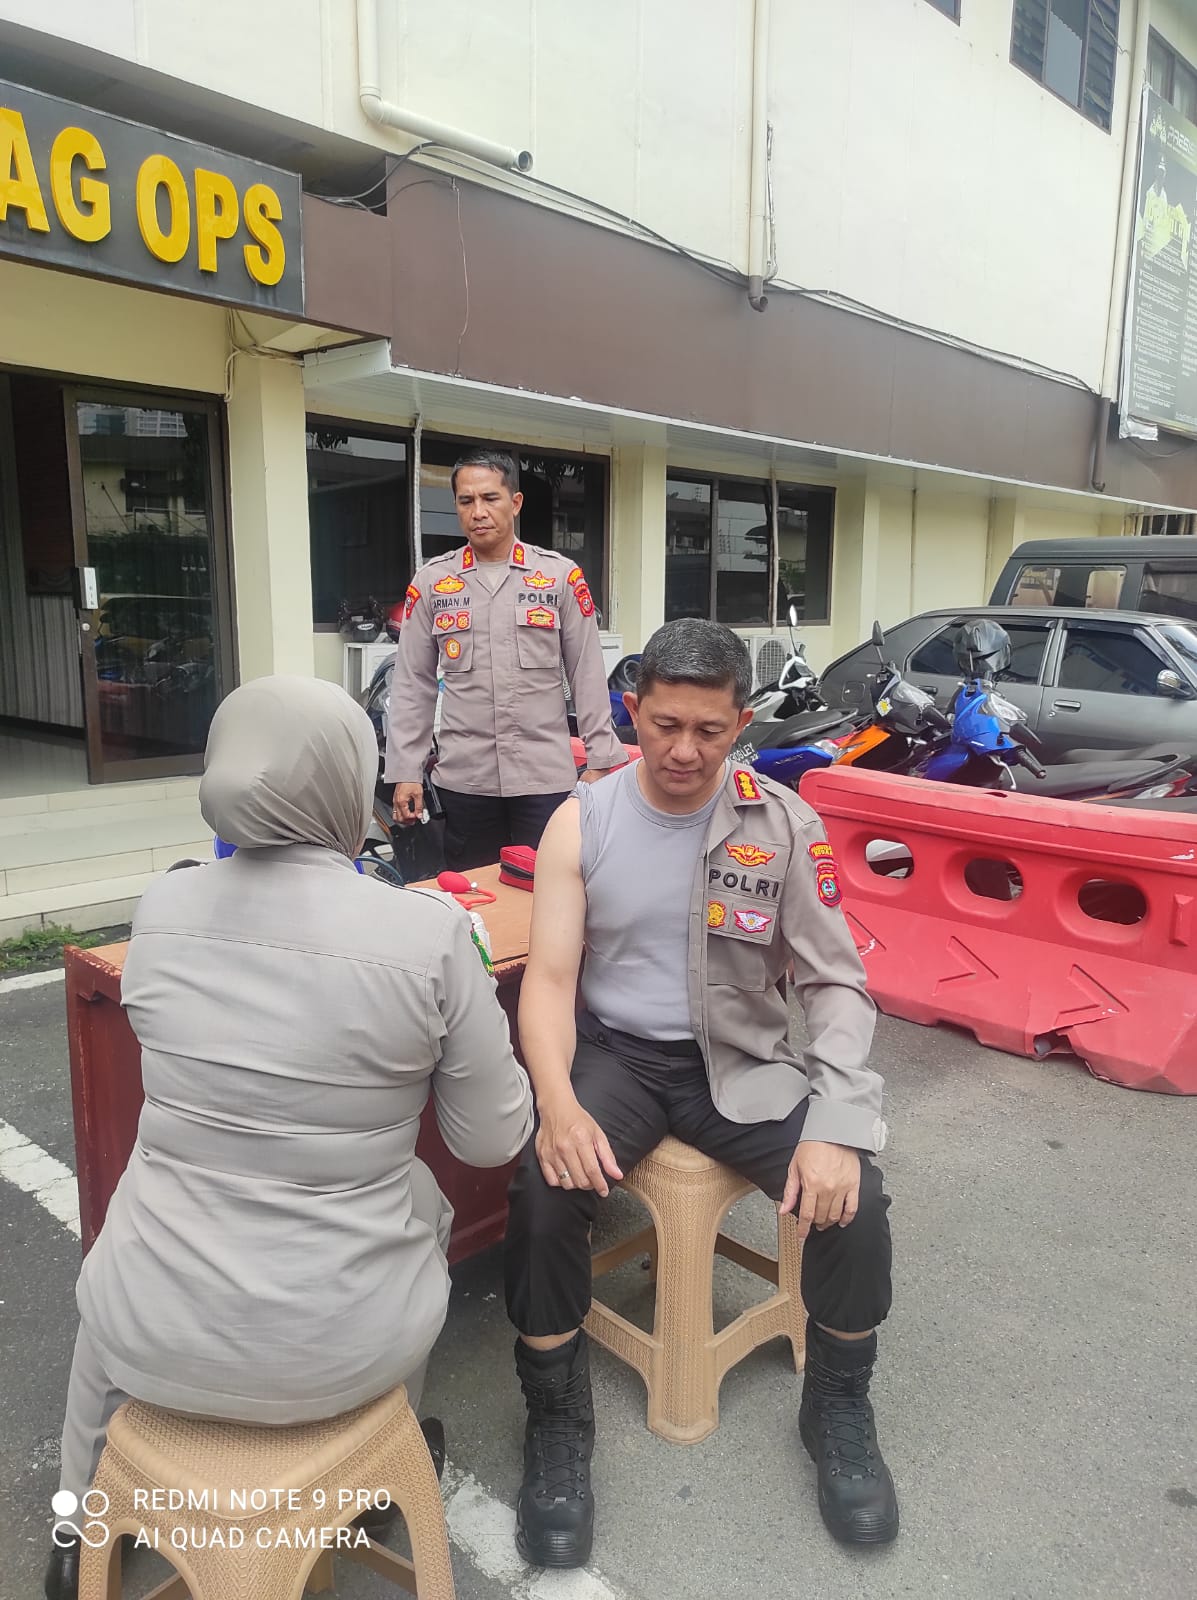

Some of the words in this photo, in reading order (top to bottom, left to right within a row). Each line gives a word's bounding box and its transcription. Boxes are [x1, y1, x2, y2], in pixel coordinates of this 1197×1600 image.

[136, 153, 287, 287] OPS
[518, 592, 559, 606] POLRI
[709, 868, 780, 898] POLRI
